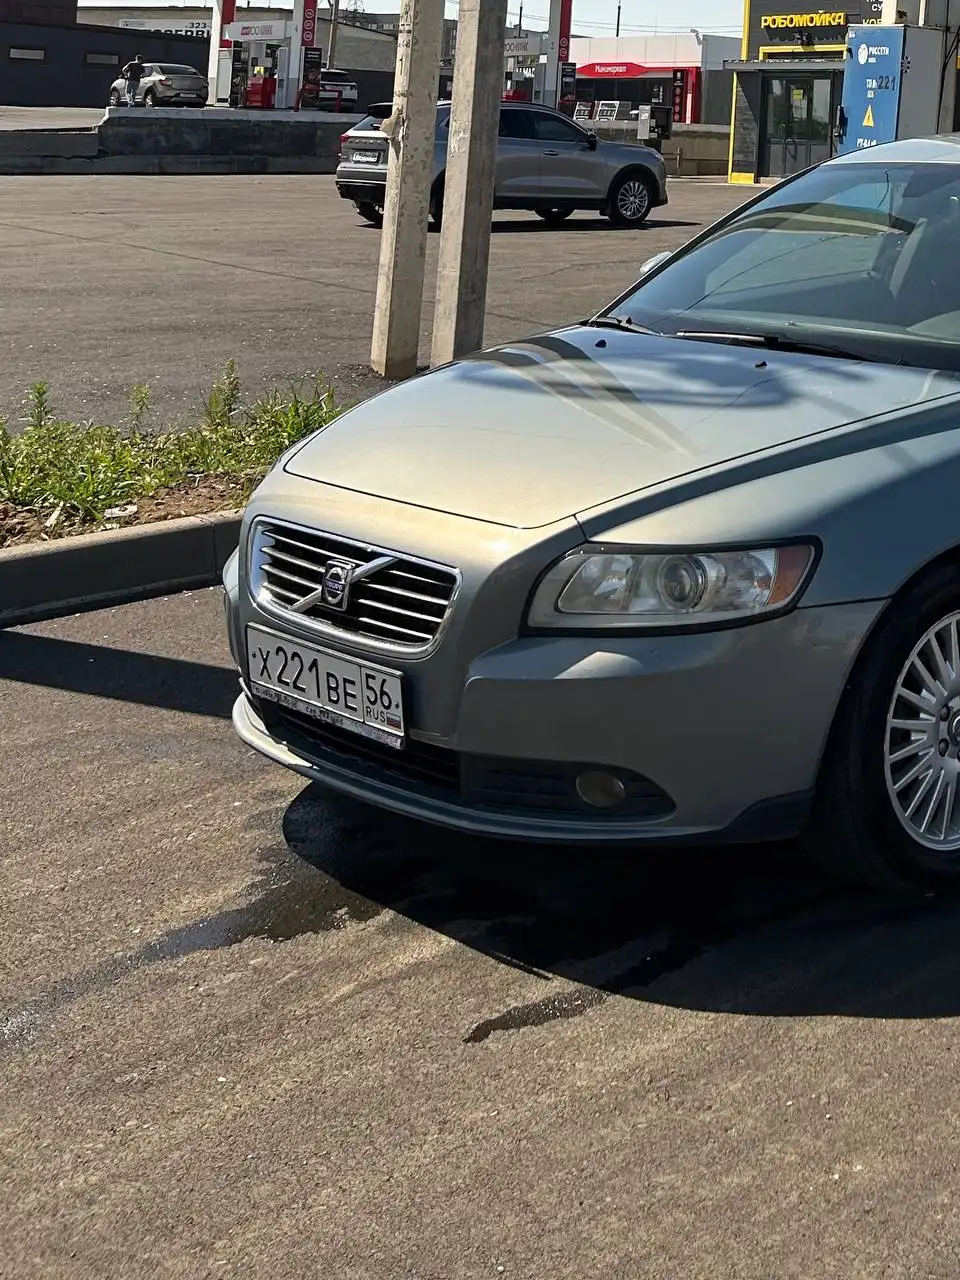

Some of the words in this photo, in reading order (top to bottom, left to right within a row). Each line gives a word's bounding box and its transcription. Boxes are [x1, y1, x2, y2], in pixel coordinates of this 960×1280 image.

[761, 10, 846, 29] РОБОМОЙКА
[868, 46, 890, 56] РОССЕТИ
[878, 76, 896, 91] 221
[365, 672, 392, 711] 56
[366, 706, 387, 724] RUS
